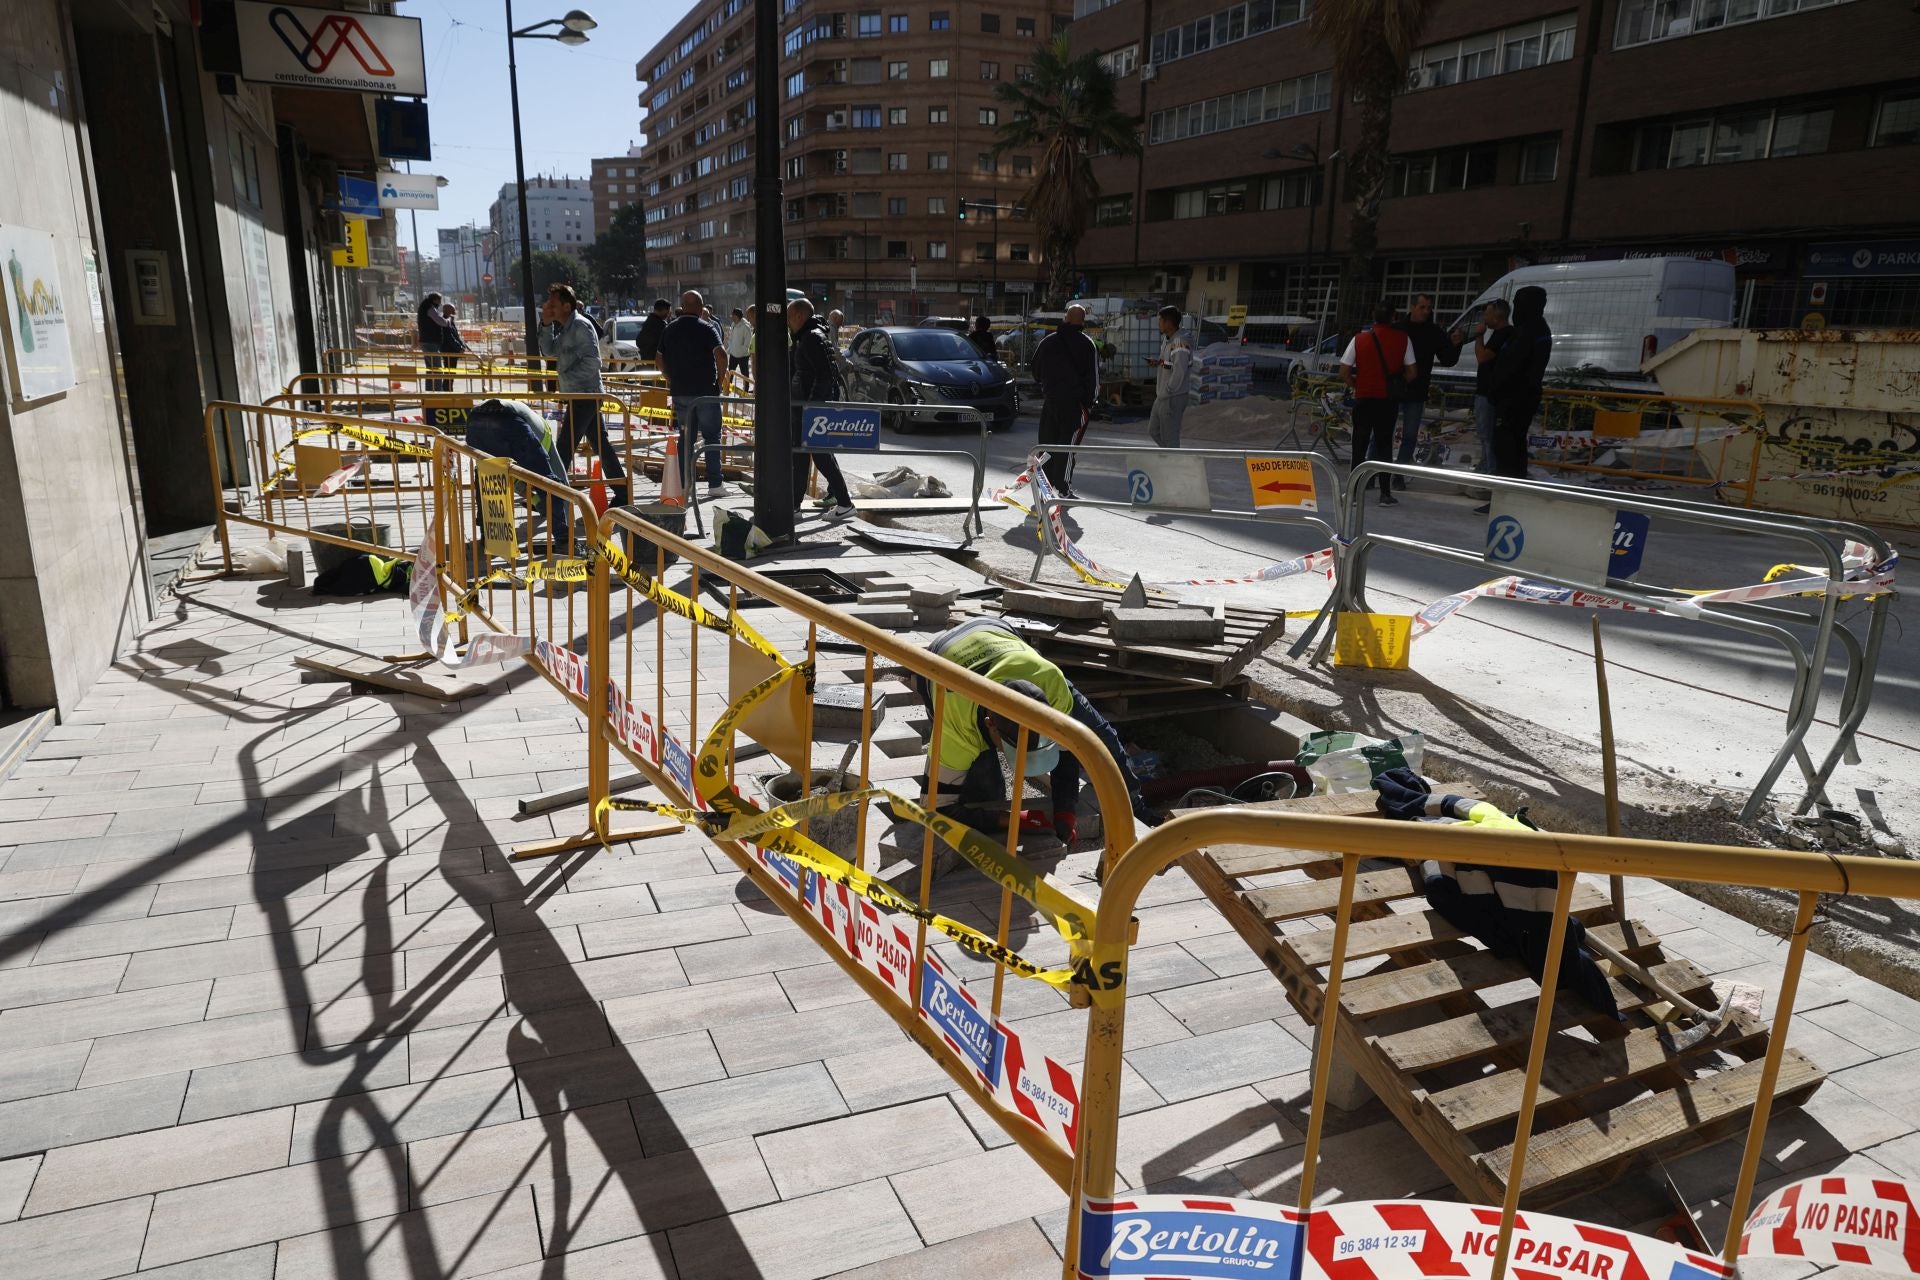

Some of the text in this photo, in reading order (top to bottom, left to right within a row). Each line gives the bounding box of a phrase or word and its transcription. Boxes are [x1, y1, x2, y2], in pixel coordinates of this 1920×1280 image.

[274, 72, 396, 90] centroformacionvallbona.es
[399, 191, 434, 200] amayores
[1251, 460, 1309, 472] PASO DE PEATONES
[481, 474, 507, 496] ACCESO
[1813, 484, 1888, 503] 961900032
[488, 500, 505, 518] SOLO
[485, 522, 514, 542] VECINOS
[632, 717, 650, 745] PASAR
[858, 920, 906, 978] NO PASAR
[1021, 1076, 1068, 1118] 96 384 12 34
[1802, 1202, 1898, 1241] NO PASAR
[1100, 1218, 1280, 1269] Bertolín
[1340, 1235, 1417, 1254] 96 384 12 34
[1222, 1256, 1255, 1268] GRUPO
[1461, 1230, 1614, 1280] NO PASAR
